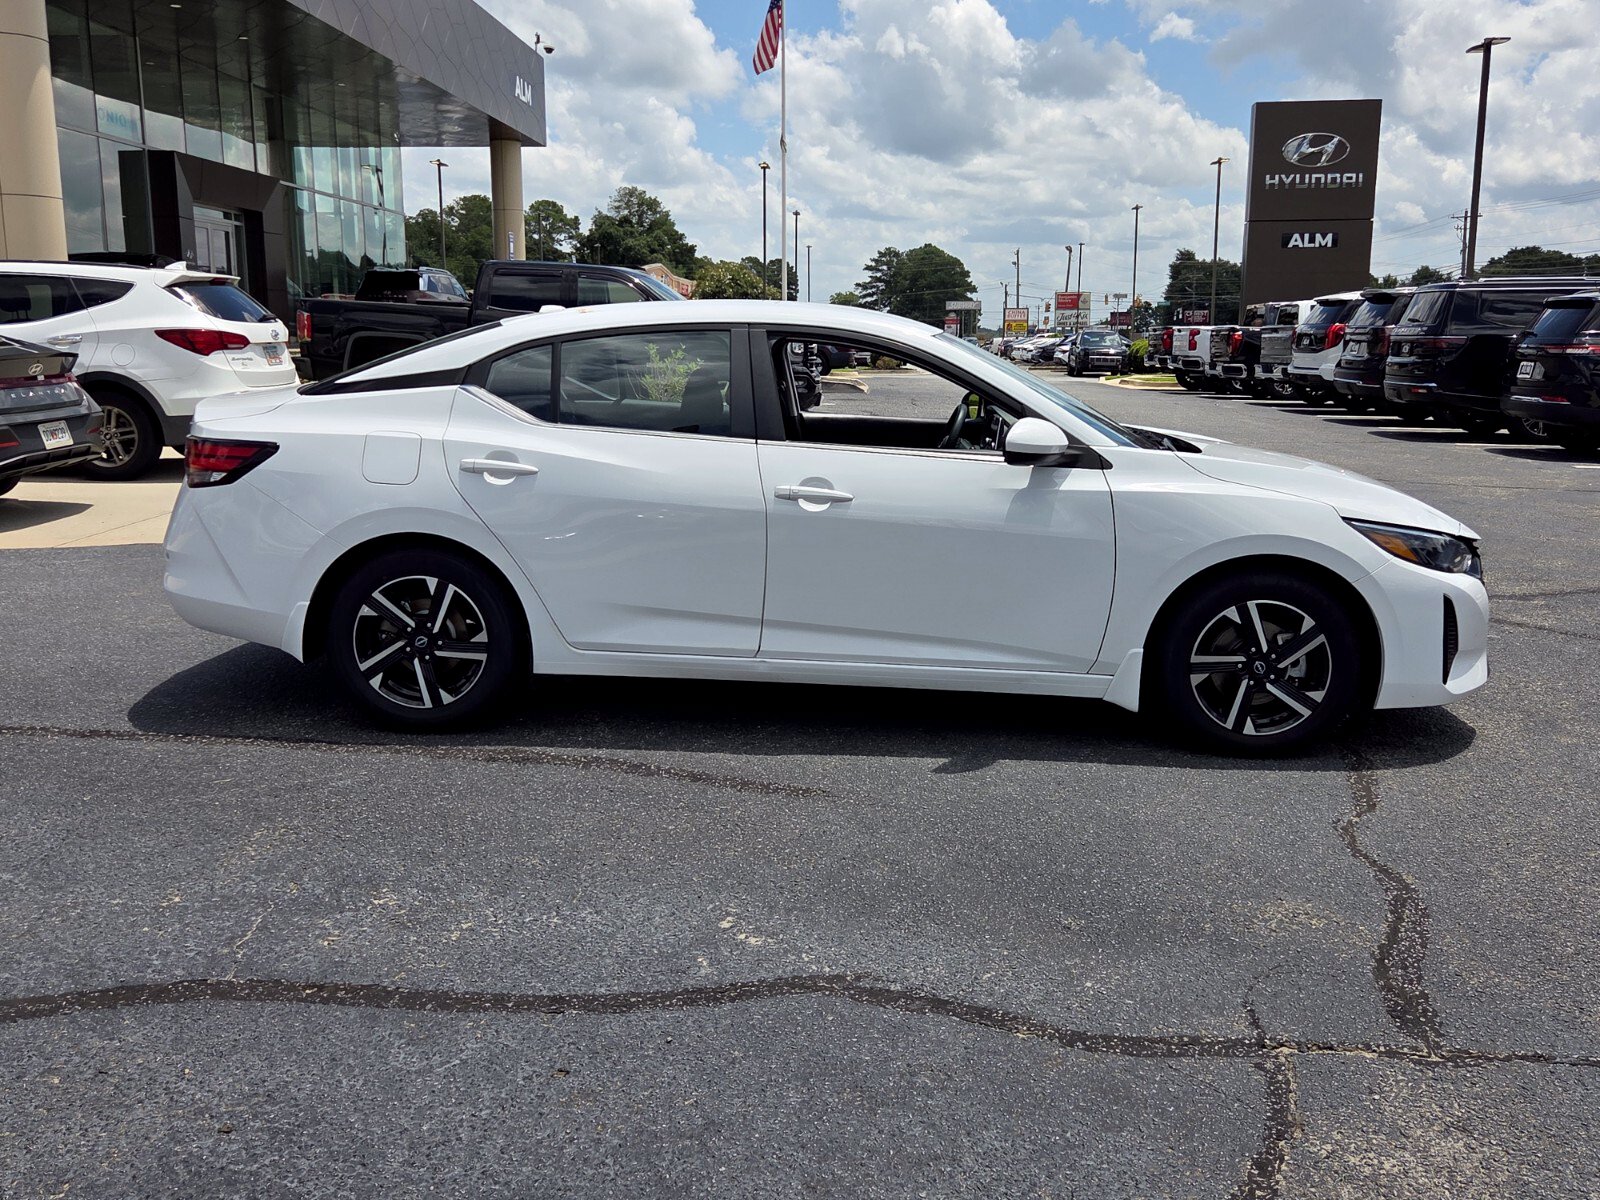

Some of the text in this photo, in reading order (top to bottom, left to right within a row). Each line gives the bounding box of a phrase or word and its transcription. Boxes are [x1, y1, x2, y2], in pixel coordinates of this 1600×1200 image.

[515, 75, 532, 107] ALM
[1265, 172, 1364, 190] HYUNDAI
[1287, 232, 1333, 248] ALM
